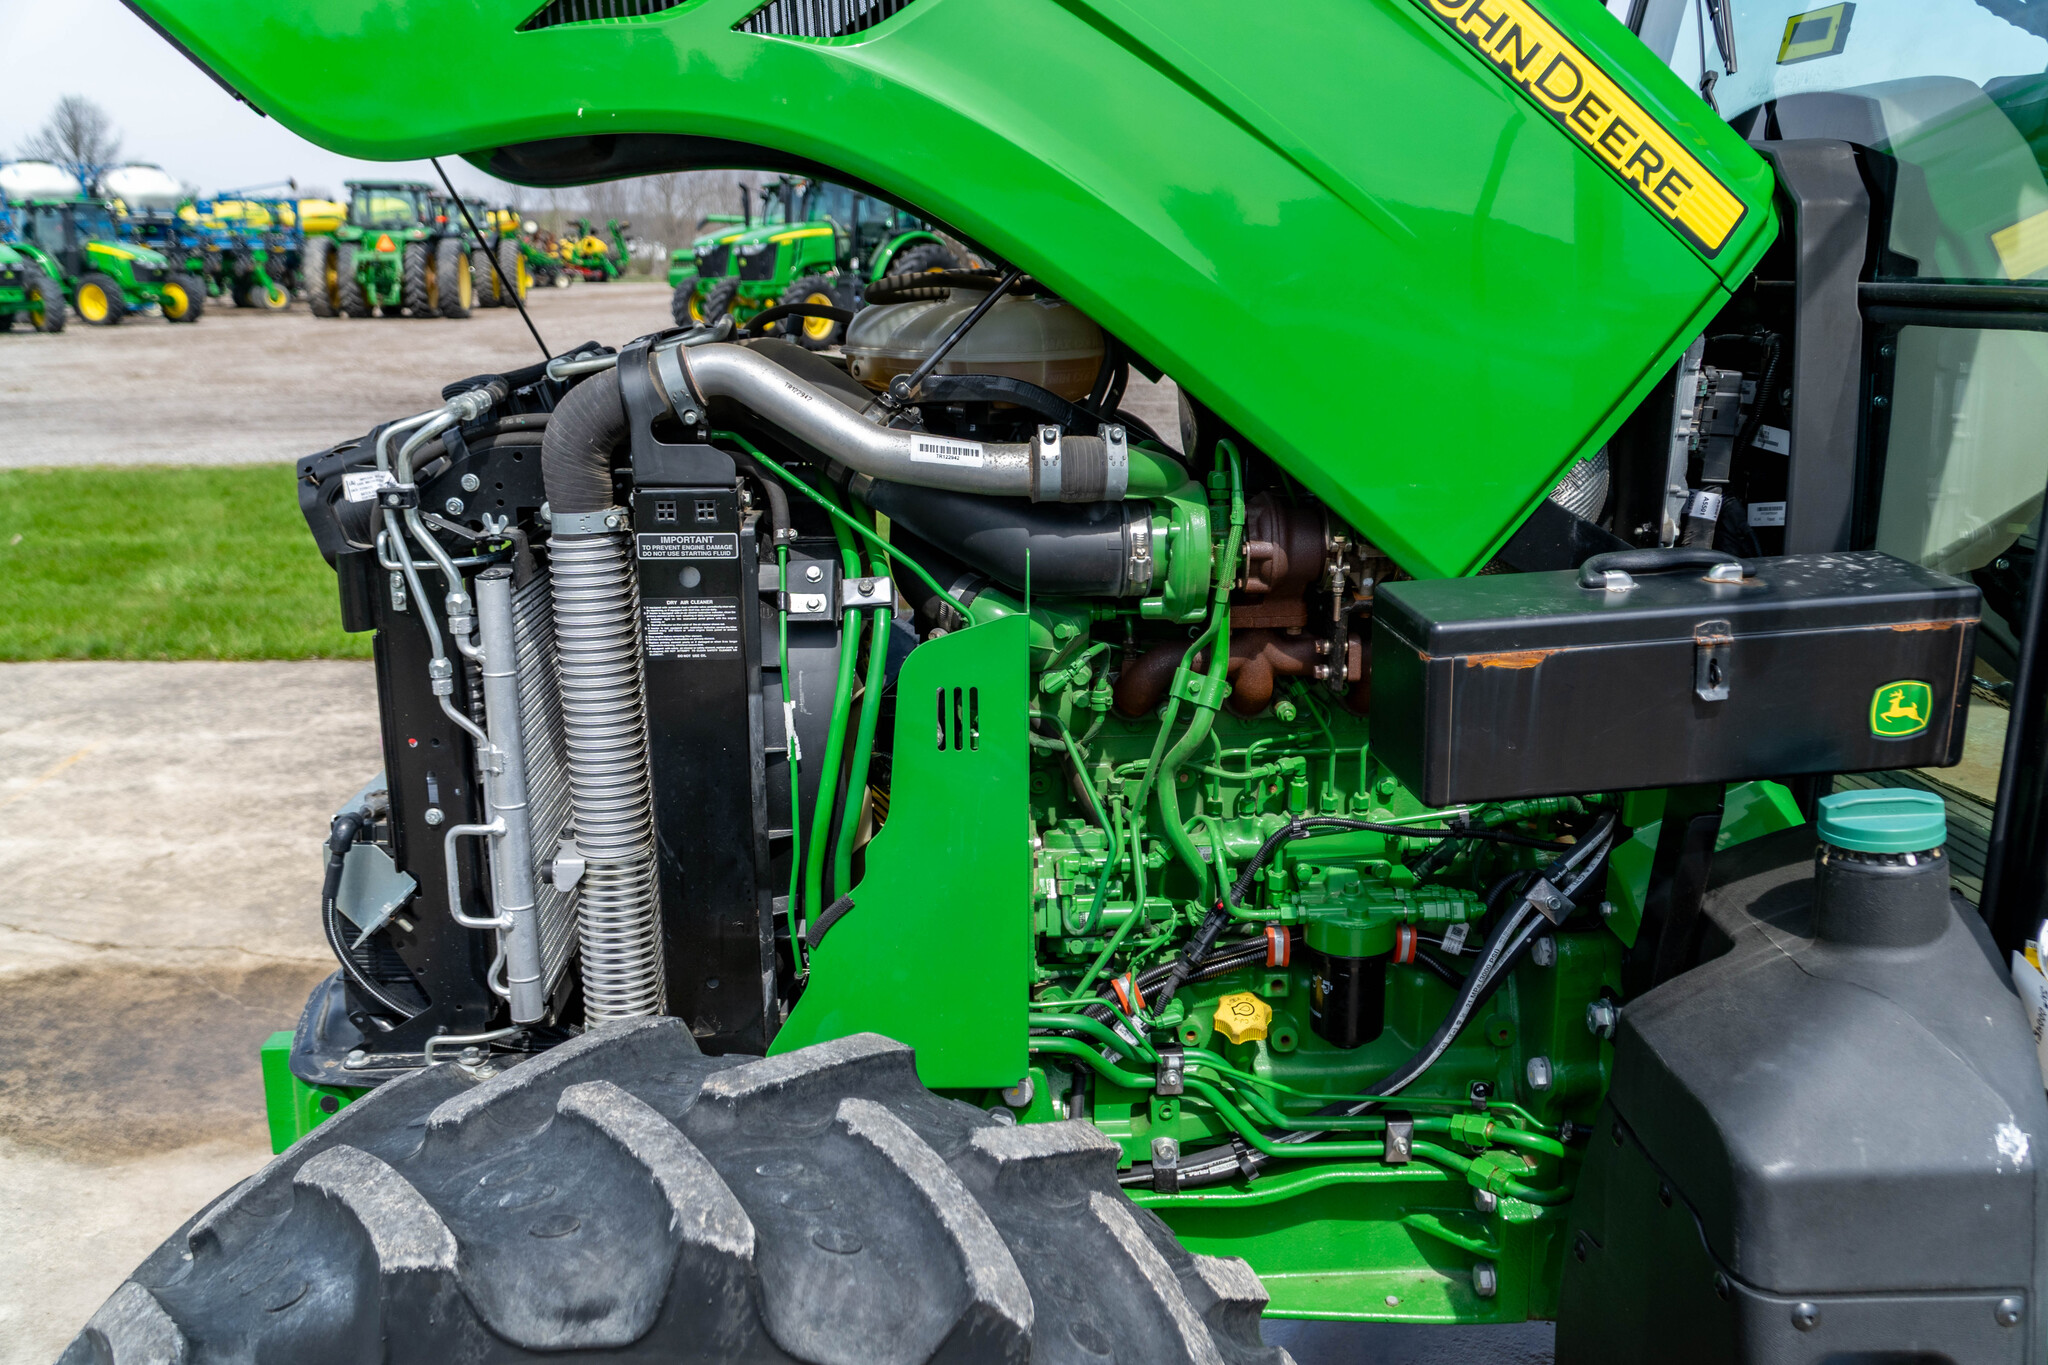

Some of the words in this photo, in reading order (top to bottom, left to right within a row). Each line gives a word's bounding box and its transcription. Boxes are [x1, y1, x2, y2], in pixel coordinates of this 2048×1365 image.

[1438, 0, 1543, 73] HN
[1534, 51, 1694, 212] DEERE
[1700, 496, 1710, 516] A5501
[660, 536, 714, 544] IMPORTANT
